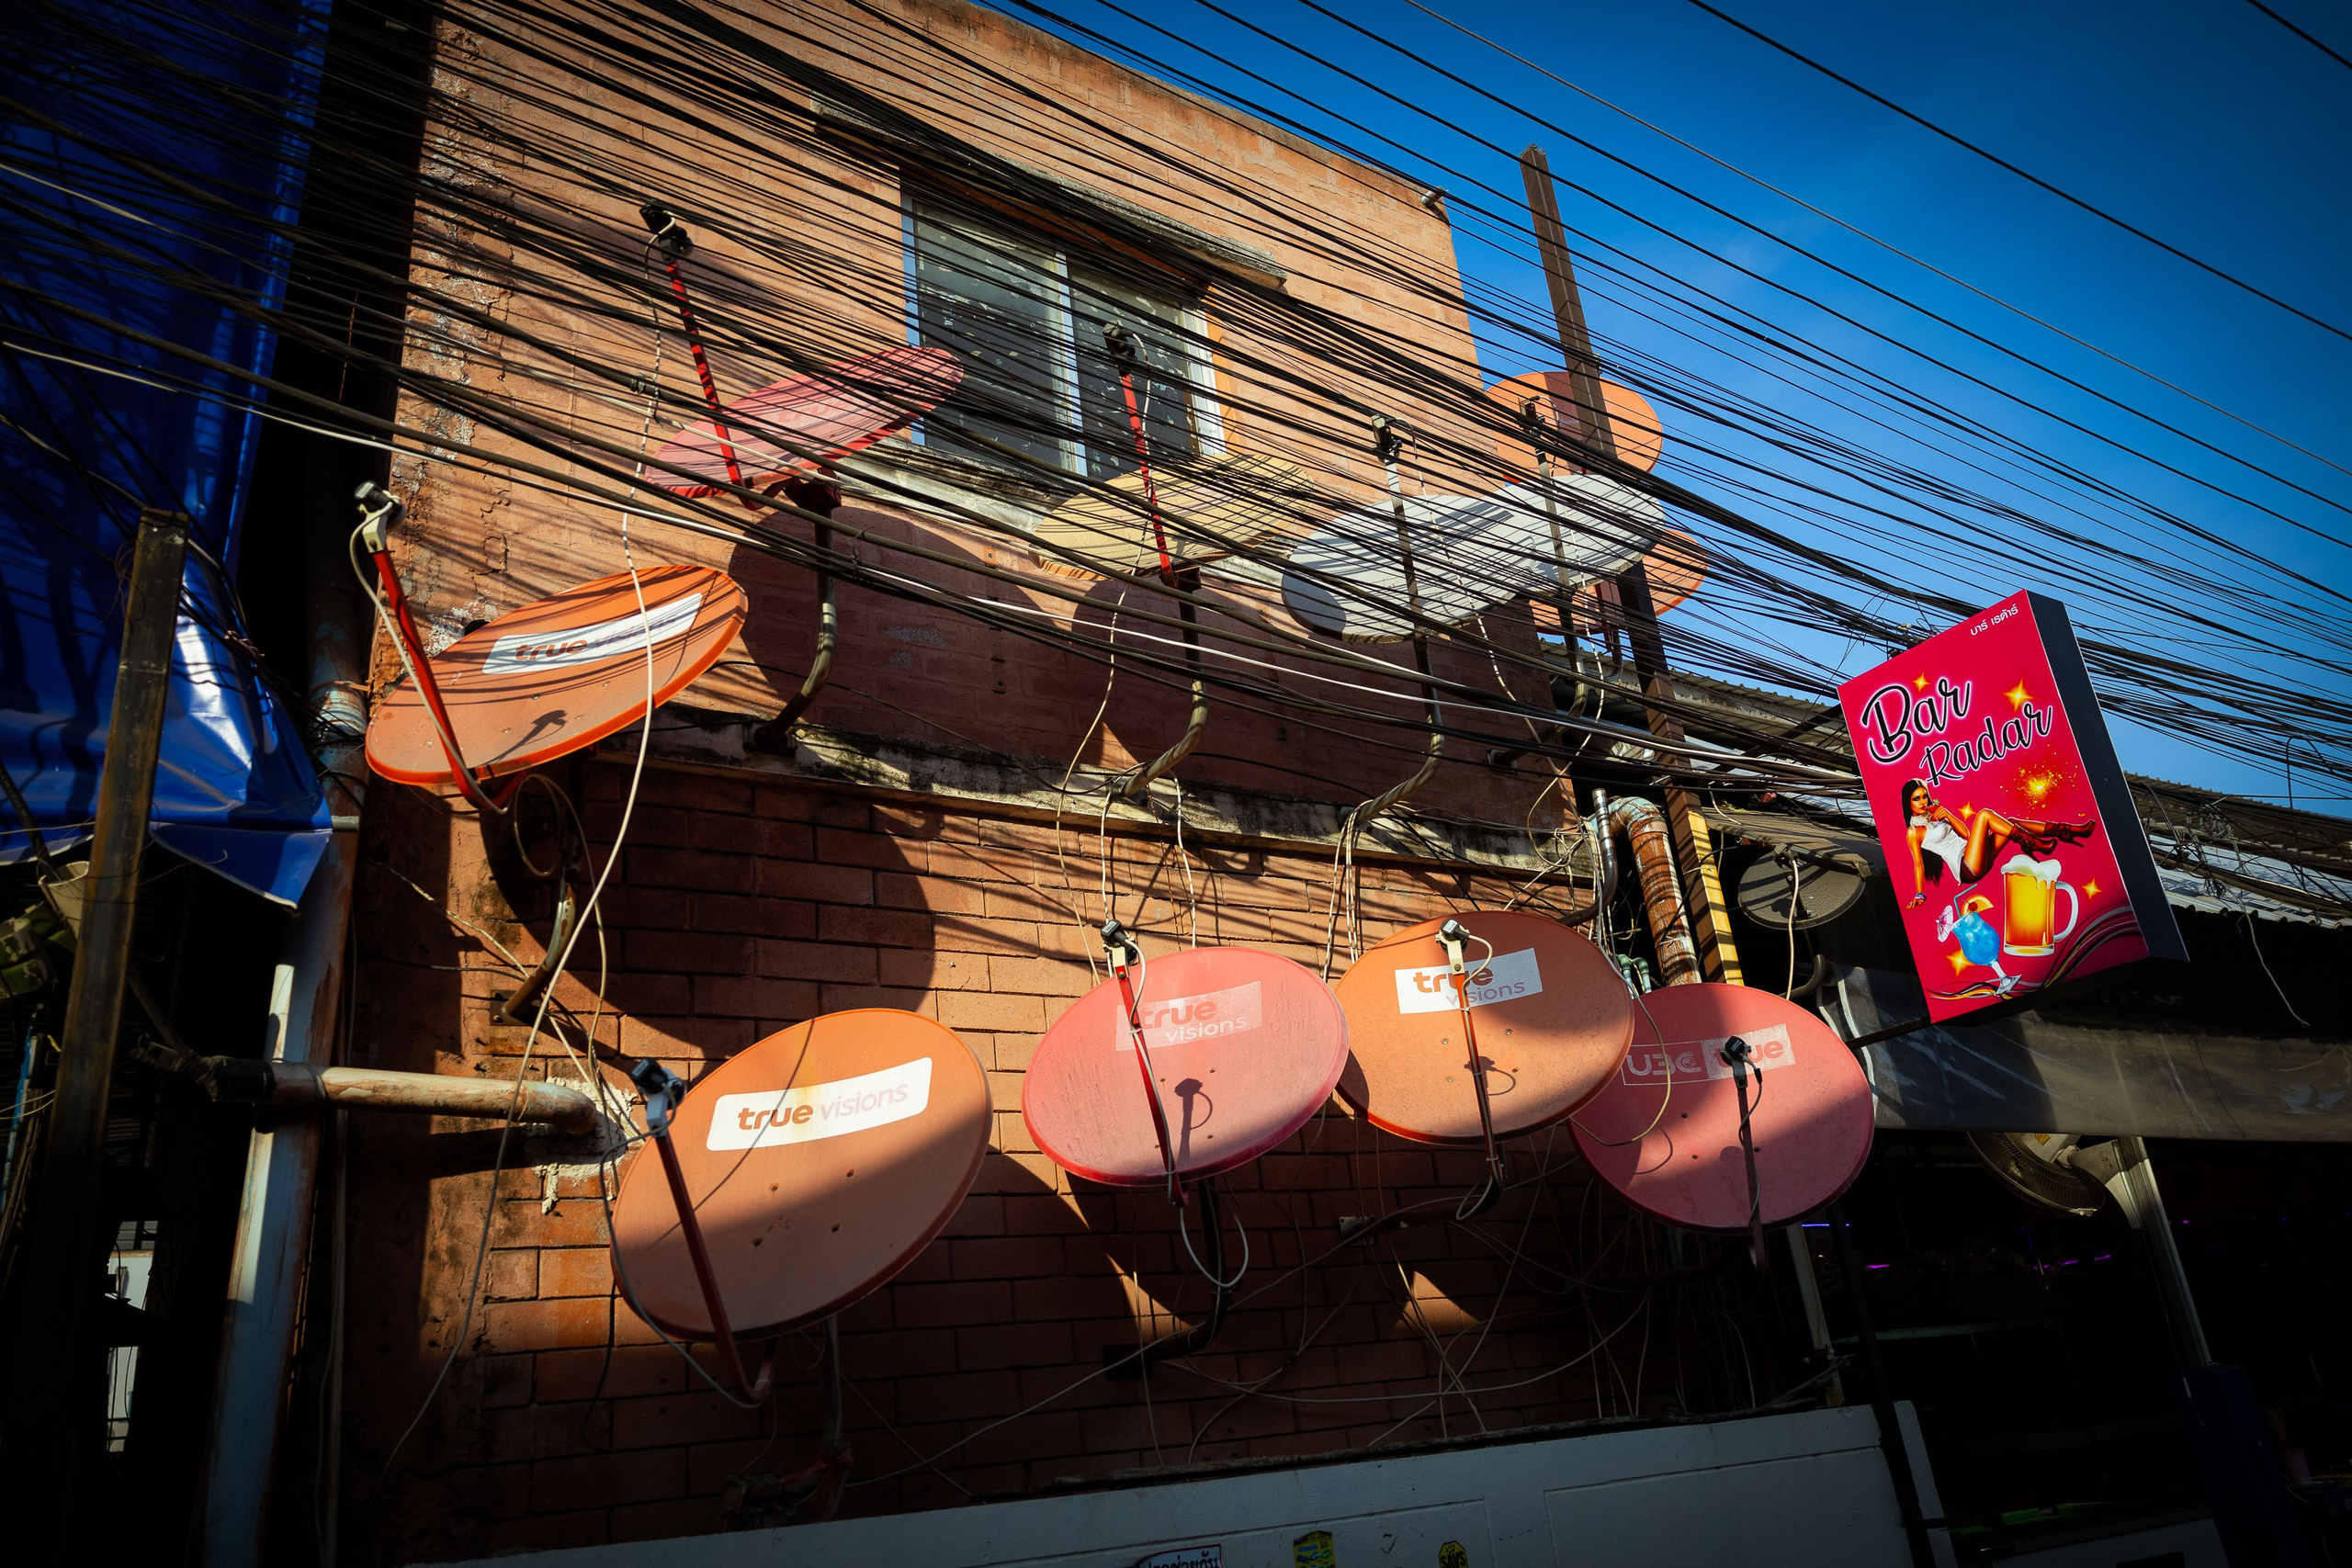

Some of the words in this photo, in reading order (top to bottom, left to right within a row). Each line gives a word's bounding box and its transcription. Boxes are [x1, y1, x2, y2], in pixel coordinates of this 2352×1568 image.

[514, 639, 588, 660] true
[1861, 676, 1972, 764] Bar
[1919, 702, 2052, 787] Radar
[1445, 981, 1526, 1007] vsions
[1139, 1001, 1217, 1030] true
[1165, 1016, 1248, 1043] visions
[1713, 1041, 1784, 1068] tue
[738, 1104, 813, 1131] true
[820, 1083, 909, 1121] visions
